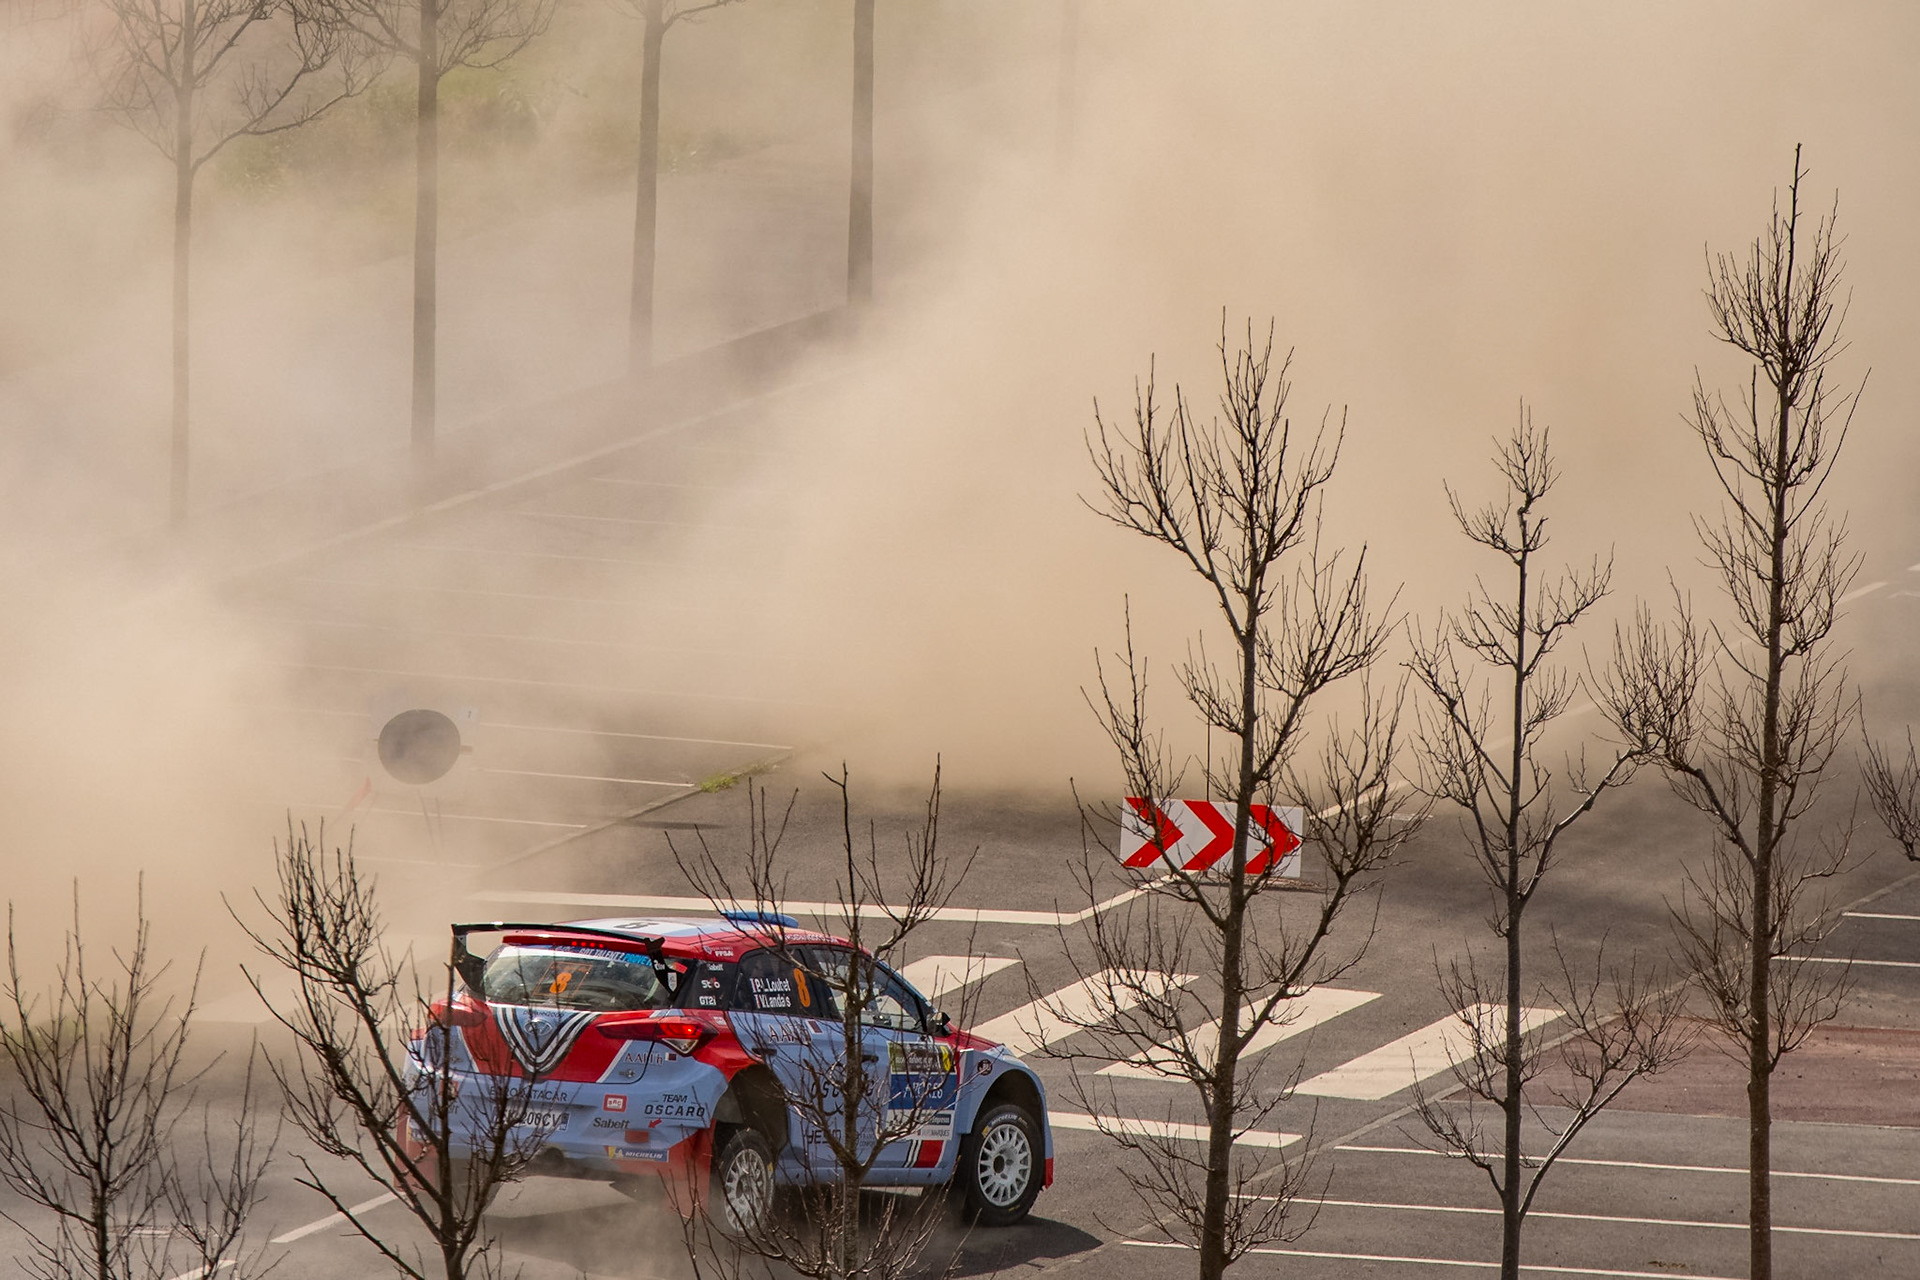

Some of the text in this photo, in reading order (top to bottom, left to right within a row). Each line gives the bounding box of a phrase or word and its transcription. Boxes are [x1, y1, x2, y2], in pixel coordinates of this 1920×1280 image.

[624, 953, 648, 965] PROVE
[549, 972, 572, 994] 8
[794, 968, 811, 1008] 8
[699, 995, 717, 1006] GT2i
[940, 1046, 951, 1071] 8
[662, 1094, 688, 1103] TEAM
[644, 1104, 705, 1117] OSCARO
[625, 1151, 664, 1159] MICHELIN
